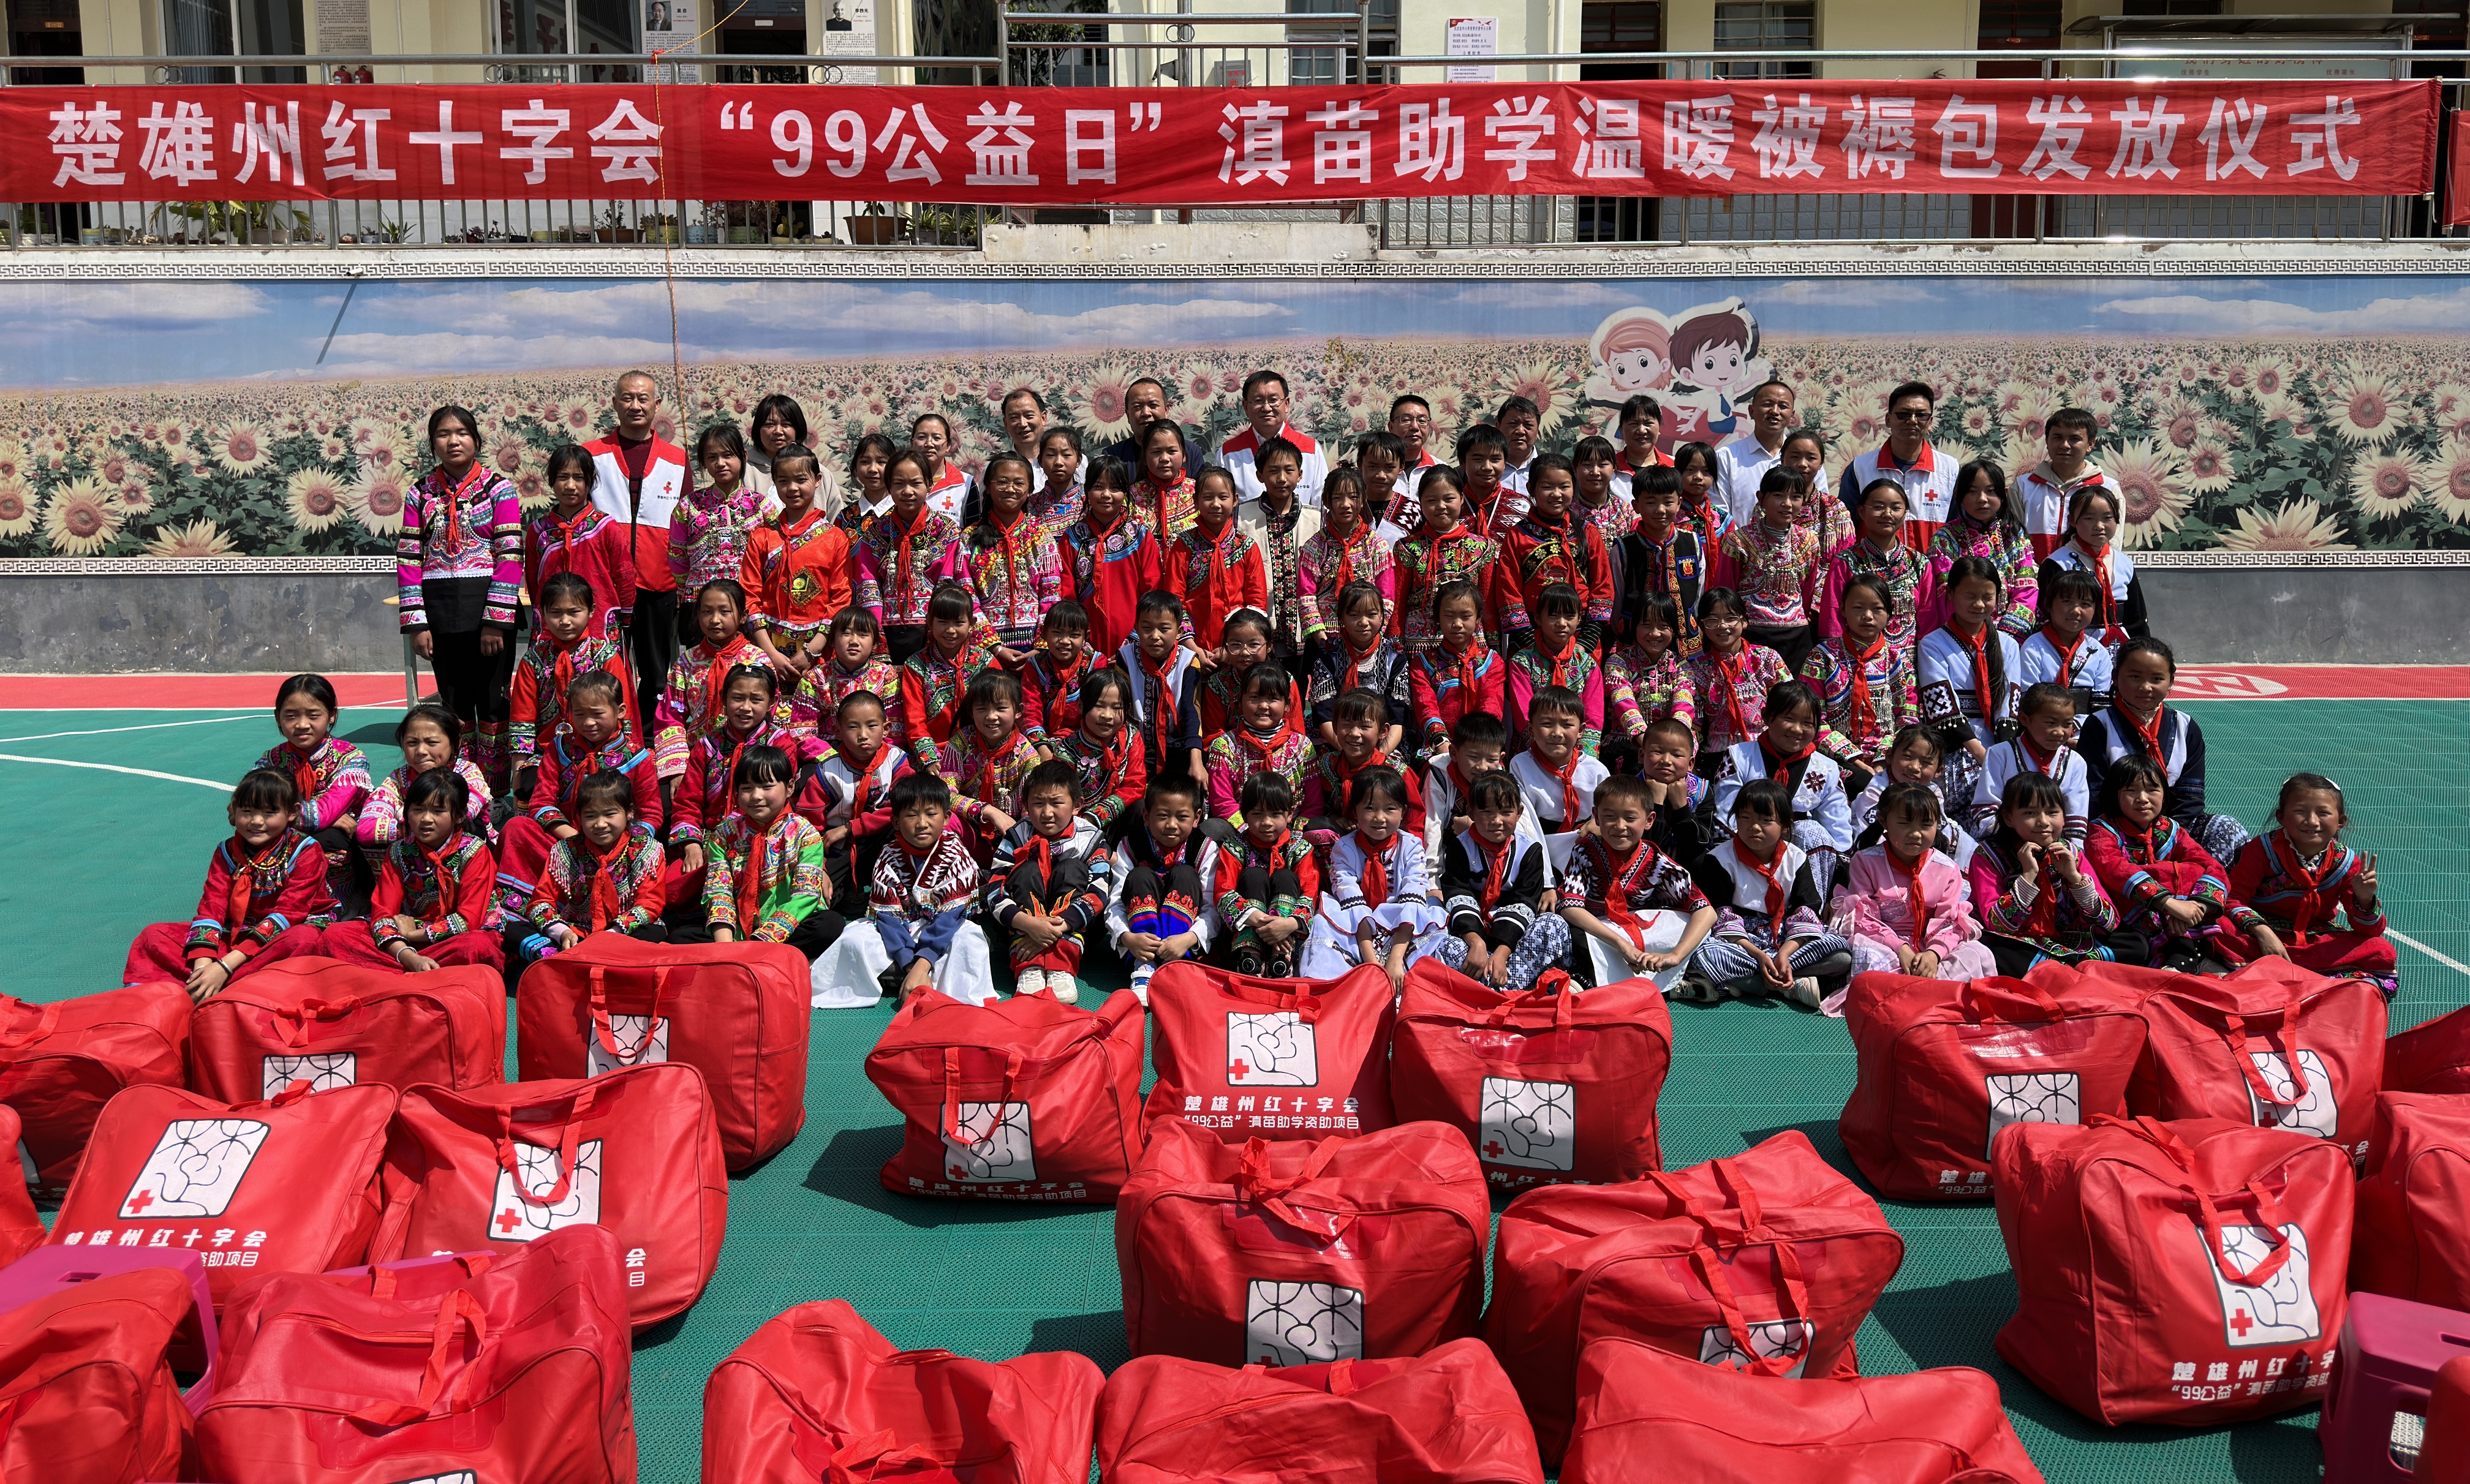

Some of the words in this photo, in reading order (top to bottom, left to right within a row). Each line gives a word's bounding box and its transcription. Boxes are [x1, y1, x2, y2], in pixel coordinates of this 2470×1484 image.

[48, 99, 663, 187] 楚雄州红十字会
[1218, 94, 2360, 187] 滇苗助学温暖被褥包发放仪式
[1184, 1096, 1359, 1112] 楚雄州红十字会
[1249, 1115, 1359, 1129] 滇苗助学资助项目
[1939, 1170, 1986, 1183] 楚雄
[909, 1177, 1084, 1192] 楚雄州红十字会
[64, 1229, 266, 1247] 楚雄州红十字会
